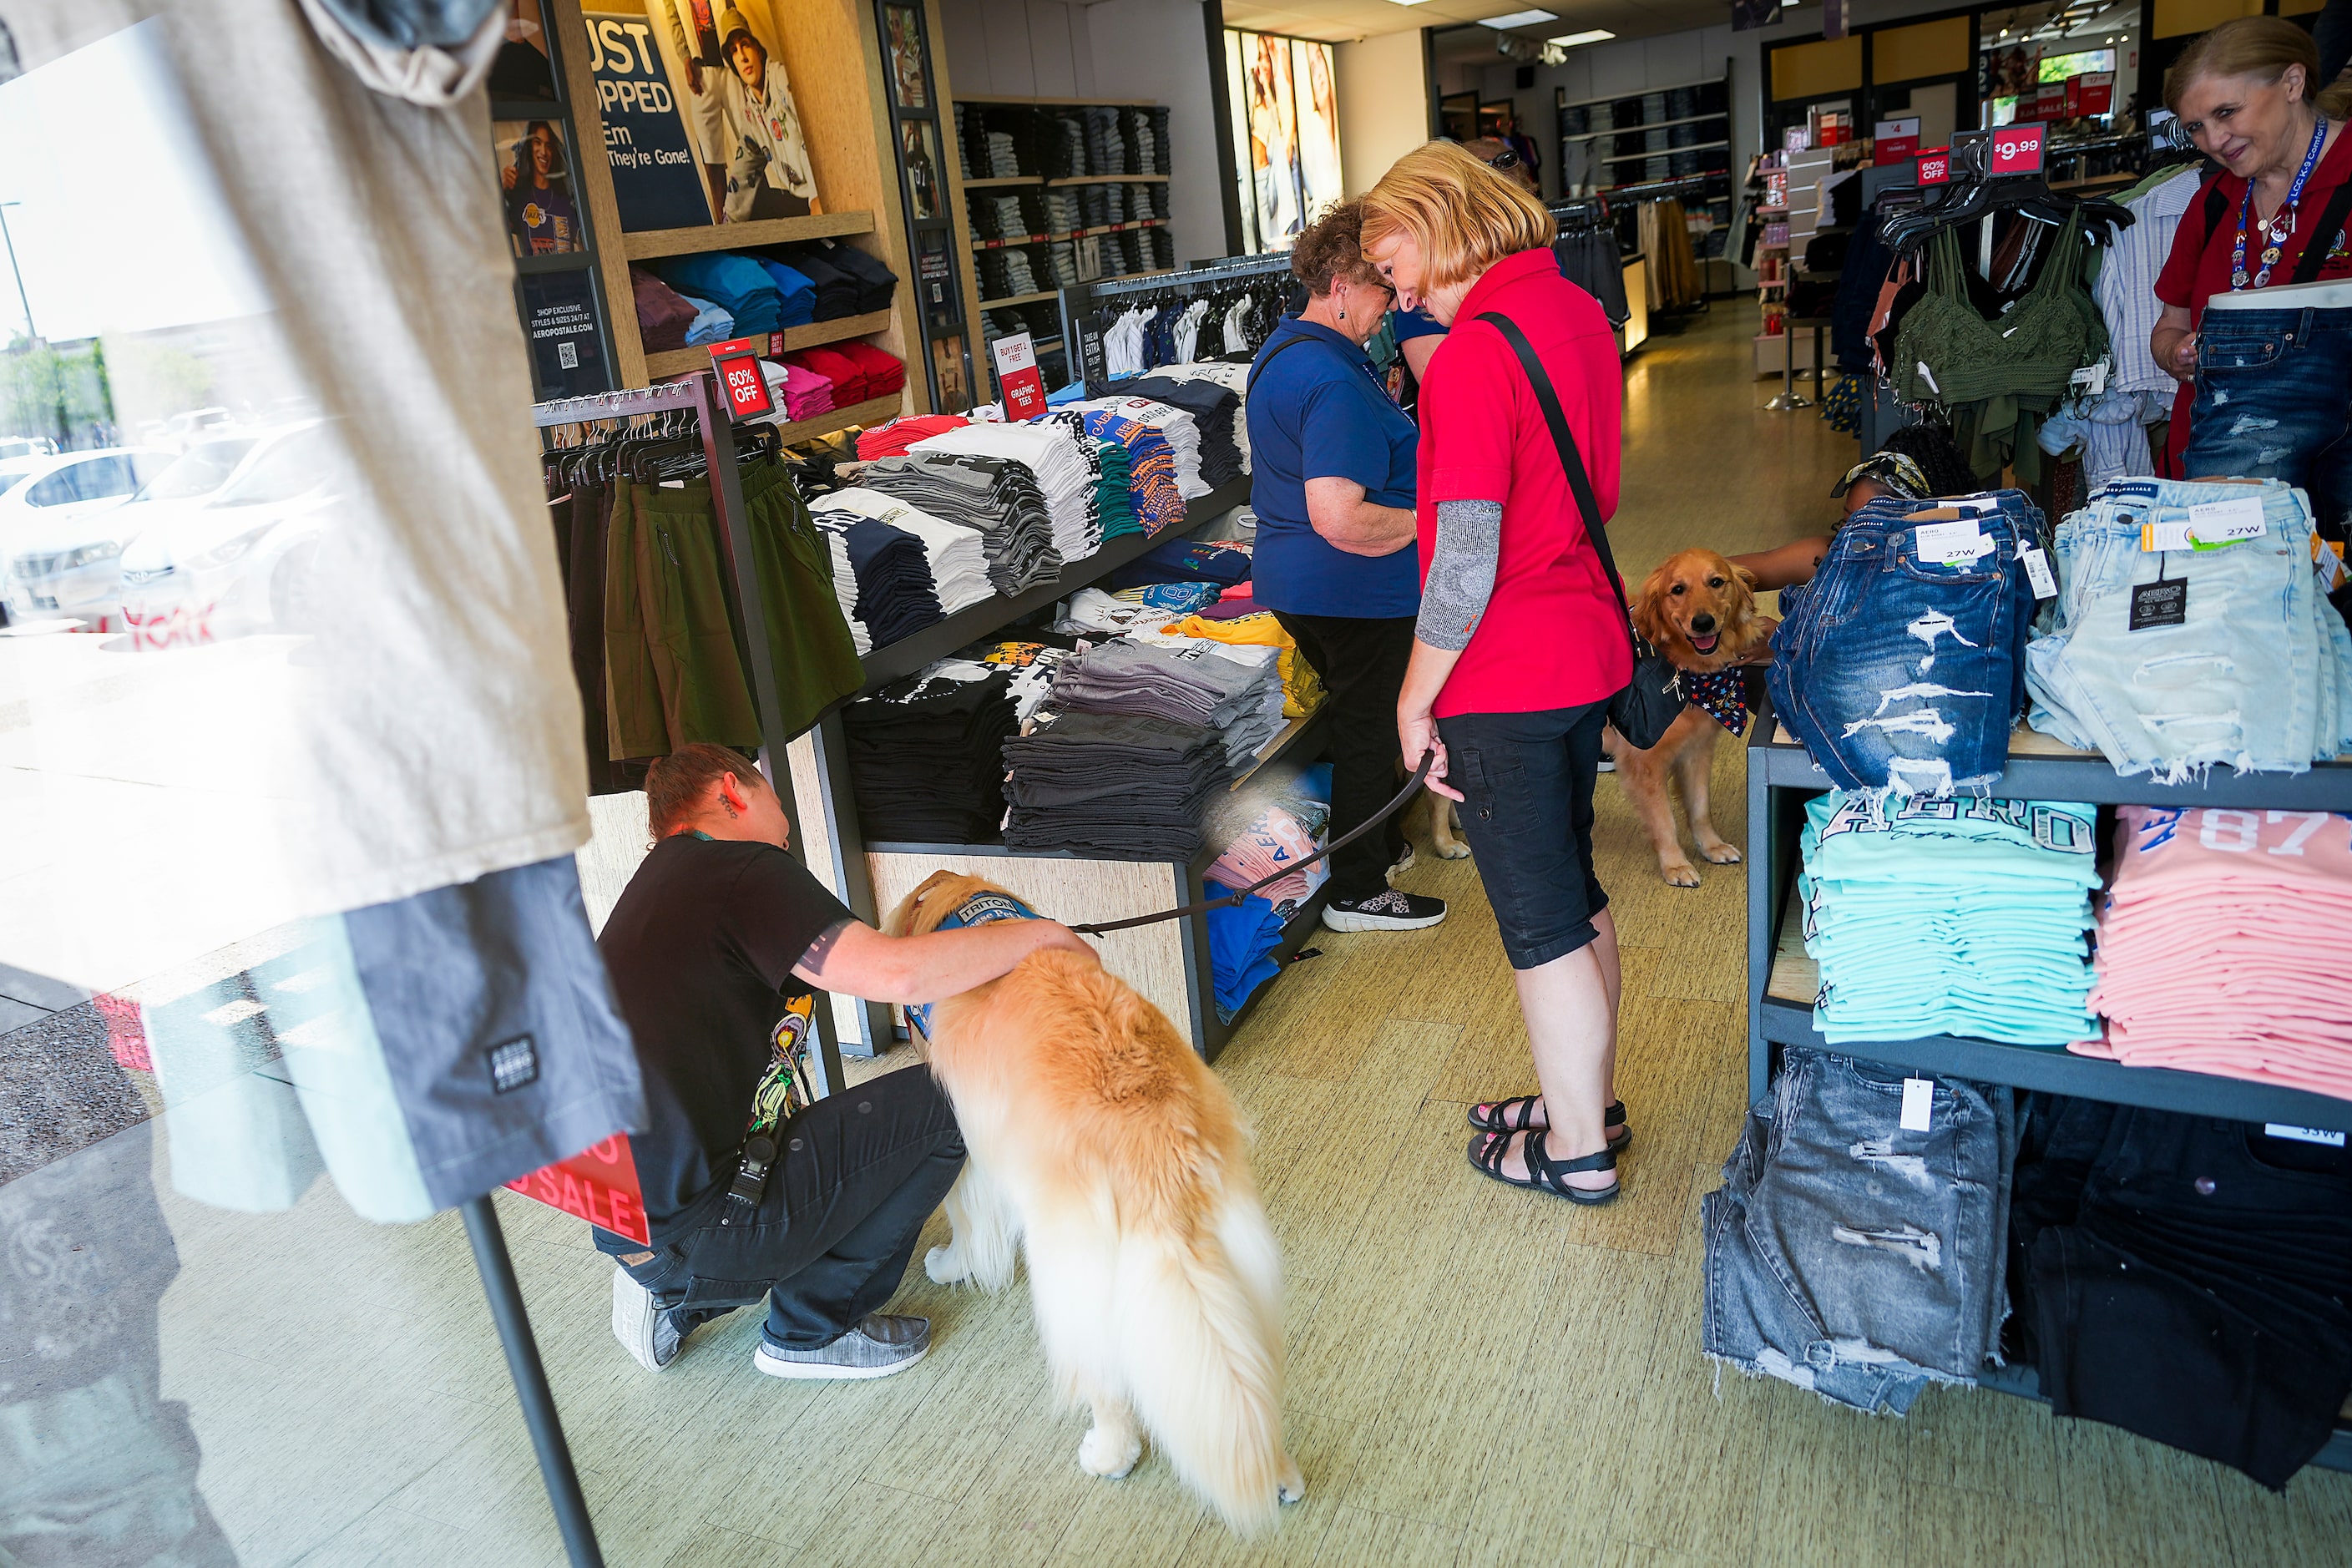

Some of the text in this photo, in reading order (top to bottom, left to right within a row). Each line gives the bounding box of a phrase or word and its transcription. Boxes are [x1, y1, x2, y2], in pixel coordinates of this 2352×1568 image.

[595, 80, 672, 113] PPED
[1995, 139, 2038, 160] $9.99
[607, 147, 690, 169] They're Gone!
[1922, 160, 1945, 172] 60%
[2290, 178, 2304, 197] LCC
[2299, 161, 2312, 178] K-9
[2308, 126, 2325, 159] Comfort
[1923, 169, 1944, 180] OFF
[536, 303, 582, 317] SHOP EXCLUSIVE
[531, 317, 550, 328] STYLES
[556, 315, 571, 325] SIZES
[571, 313, 584, 323] 24/7
[533, 322, 594, 340] AEROPOSTALE.COM
[1000, 347, 1010, 357] BUY
[1013, 342, 1023, 352] GET
[1085, 341, 1100, 357] EXTRA
[1009, 353, 1022, 364] FREE
[727, 368, 756, 387] 60%
[735, 384, 758, 403] OFF
[1010, 383, 1035, 399] GRAPHIC
[1019, 395, 1032, 407] TEES
[2227, 525, 2260, 536] 27W
[1946, 549, 1975, 558] 27W
[2199, 808, 2329, 856] 87
[961, 899, 1014, 918] TRITON
[994, 909, 1015, 919] Pet
[537, 1166, 635, 1237] SALE
